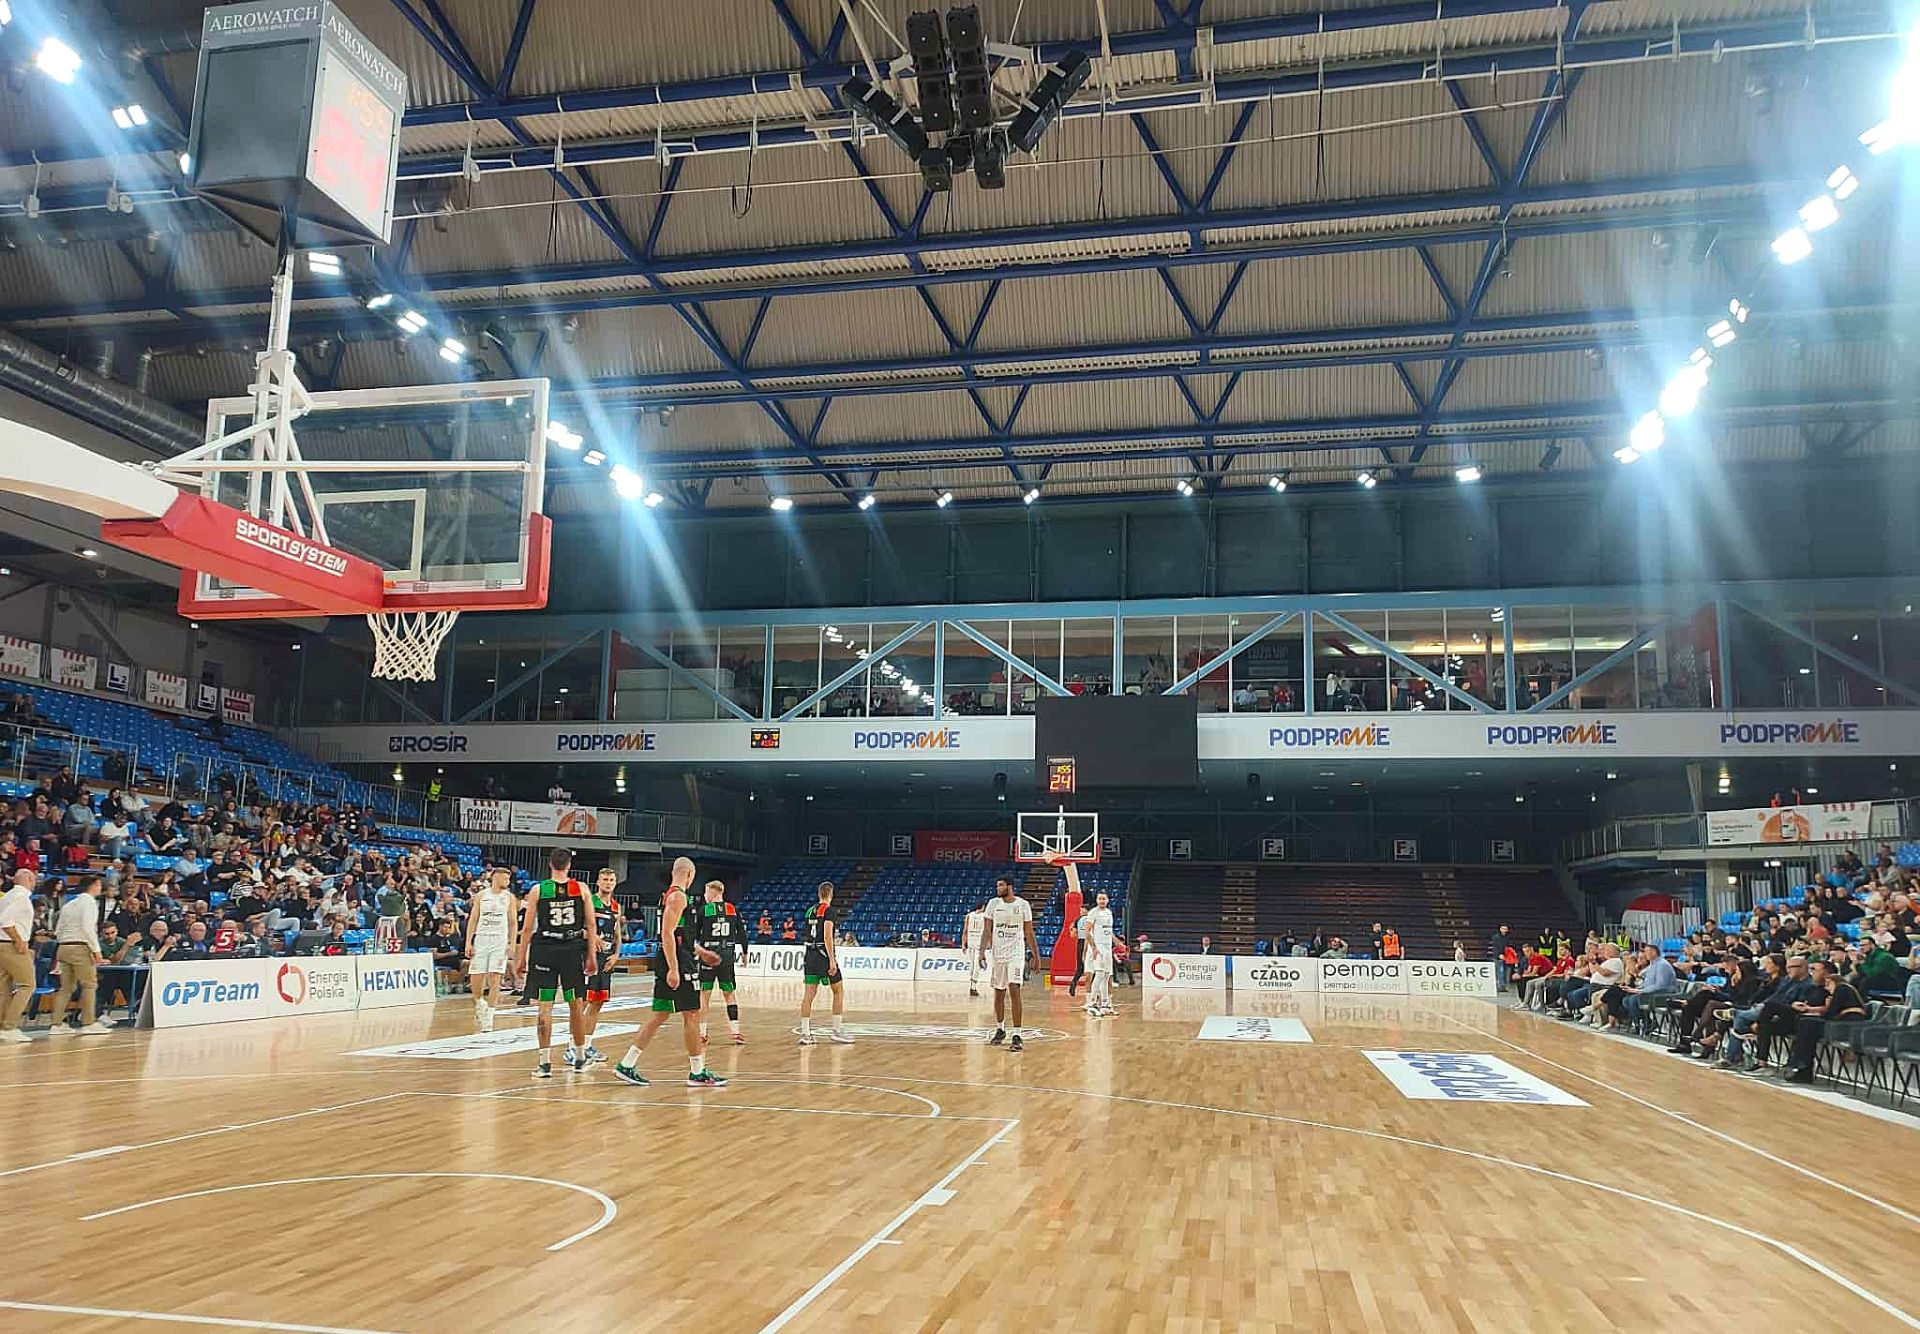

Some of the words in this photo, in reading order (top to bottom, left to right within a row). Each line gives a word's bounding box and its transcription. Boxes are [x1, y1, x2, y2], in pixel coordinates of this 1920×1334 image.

[209, 6, 318, 31] AEROWATCH
[328, 15, 404, 94] AEROWATCH
[235, 518, 348, 574] SPORTSYSTEM
[557, 729, 656, 751] PODPROMIE
[854, 727, 960, 749] PODPROMIE
[1269, 723, 1390, 747] PODPROMIE
[1488, 719, 1617, 745] PODPROMIE
[1720, 718, 1860, 744] PODPROMIE
[1049, 774, 1071, 790] 24
[549, 907, 576, 926] 33
[711, 922, 730, 937] 20
[217, 931, 233, 947] 5
[771, 950, 805, 971] COC
[843, 956, 909, 970] HEATING
[1178, 962, 1217, 974] Energia
[308, 969, 349, 986] Energia
[363, 968, 430, 992] HEATING
[1178, 972, 1213, 981] Polska
[1250, 969, 1301, 981] CZADO
[1322, 963, 1400, 981] pempa
[1411, 965, 1491, 978] SOLARE
[162, 979, 260, 1007] OPTeam
[308, 985, 345, 1000] Polska
[1420, 981, 1485, 992] ENERGY
